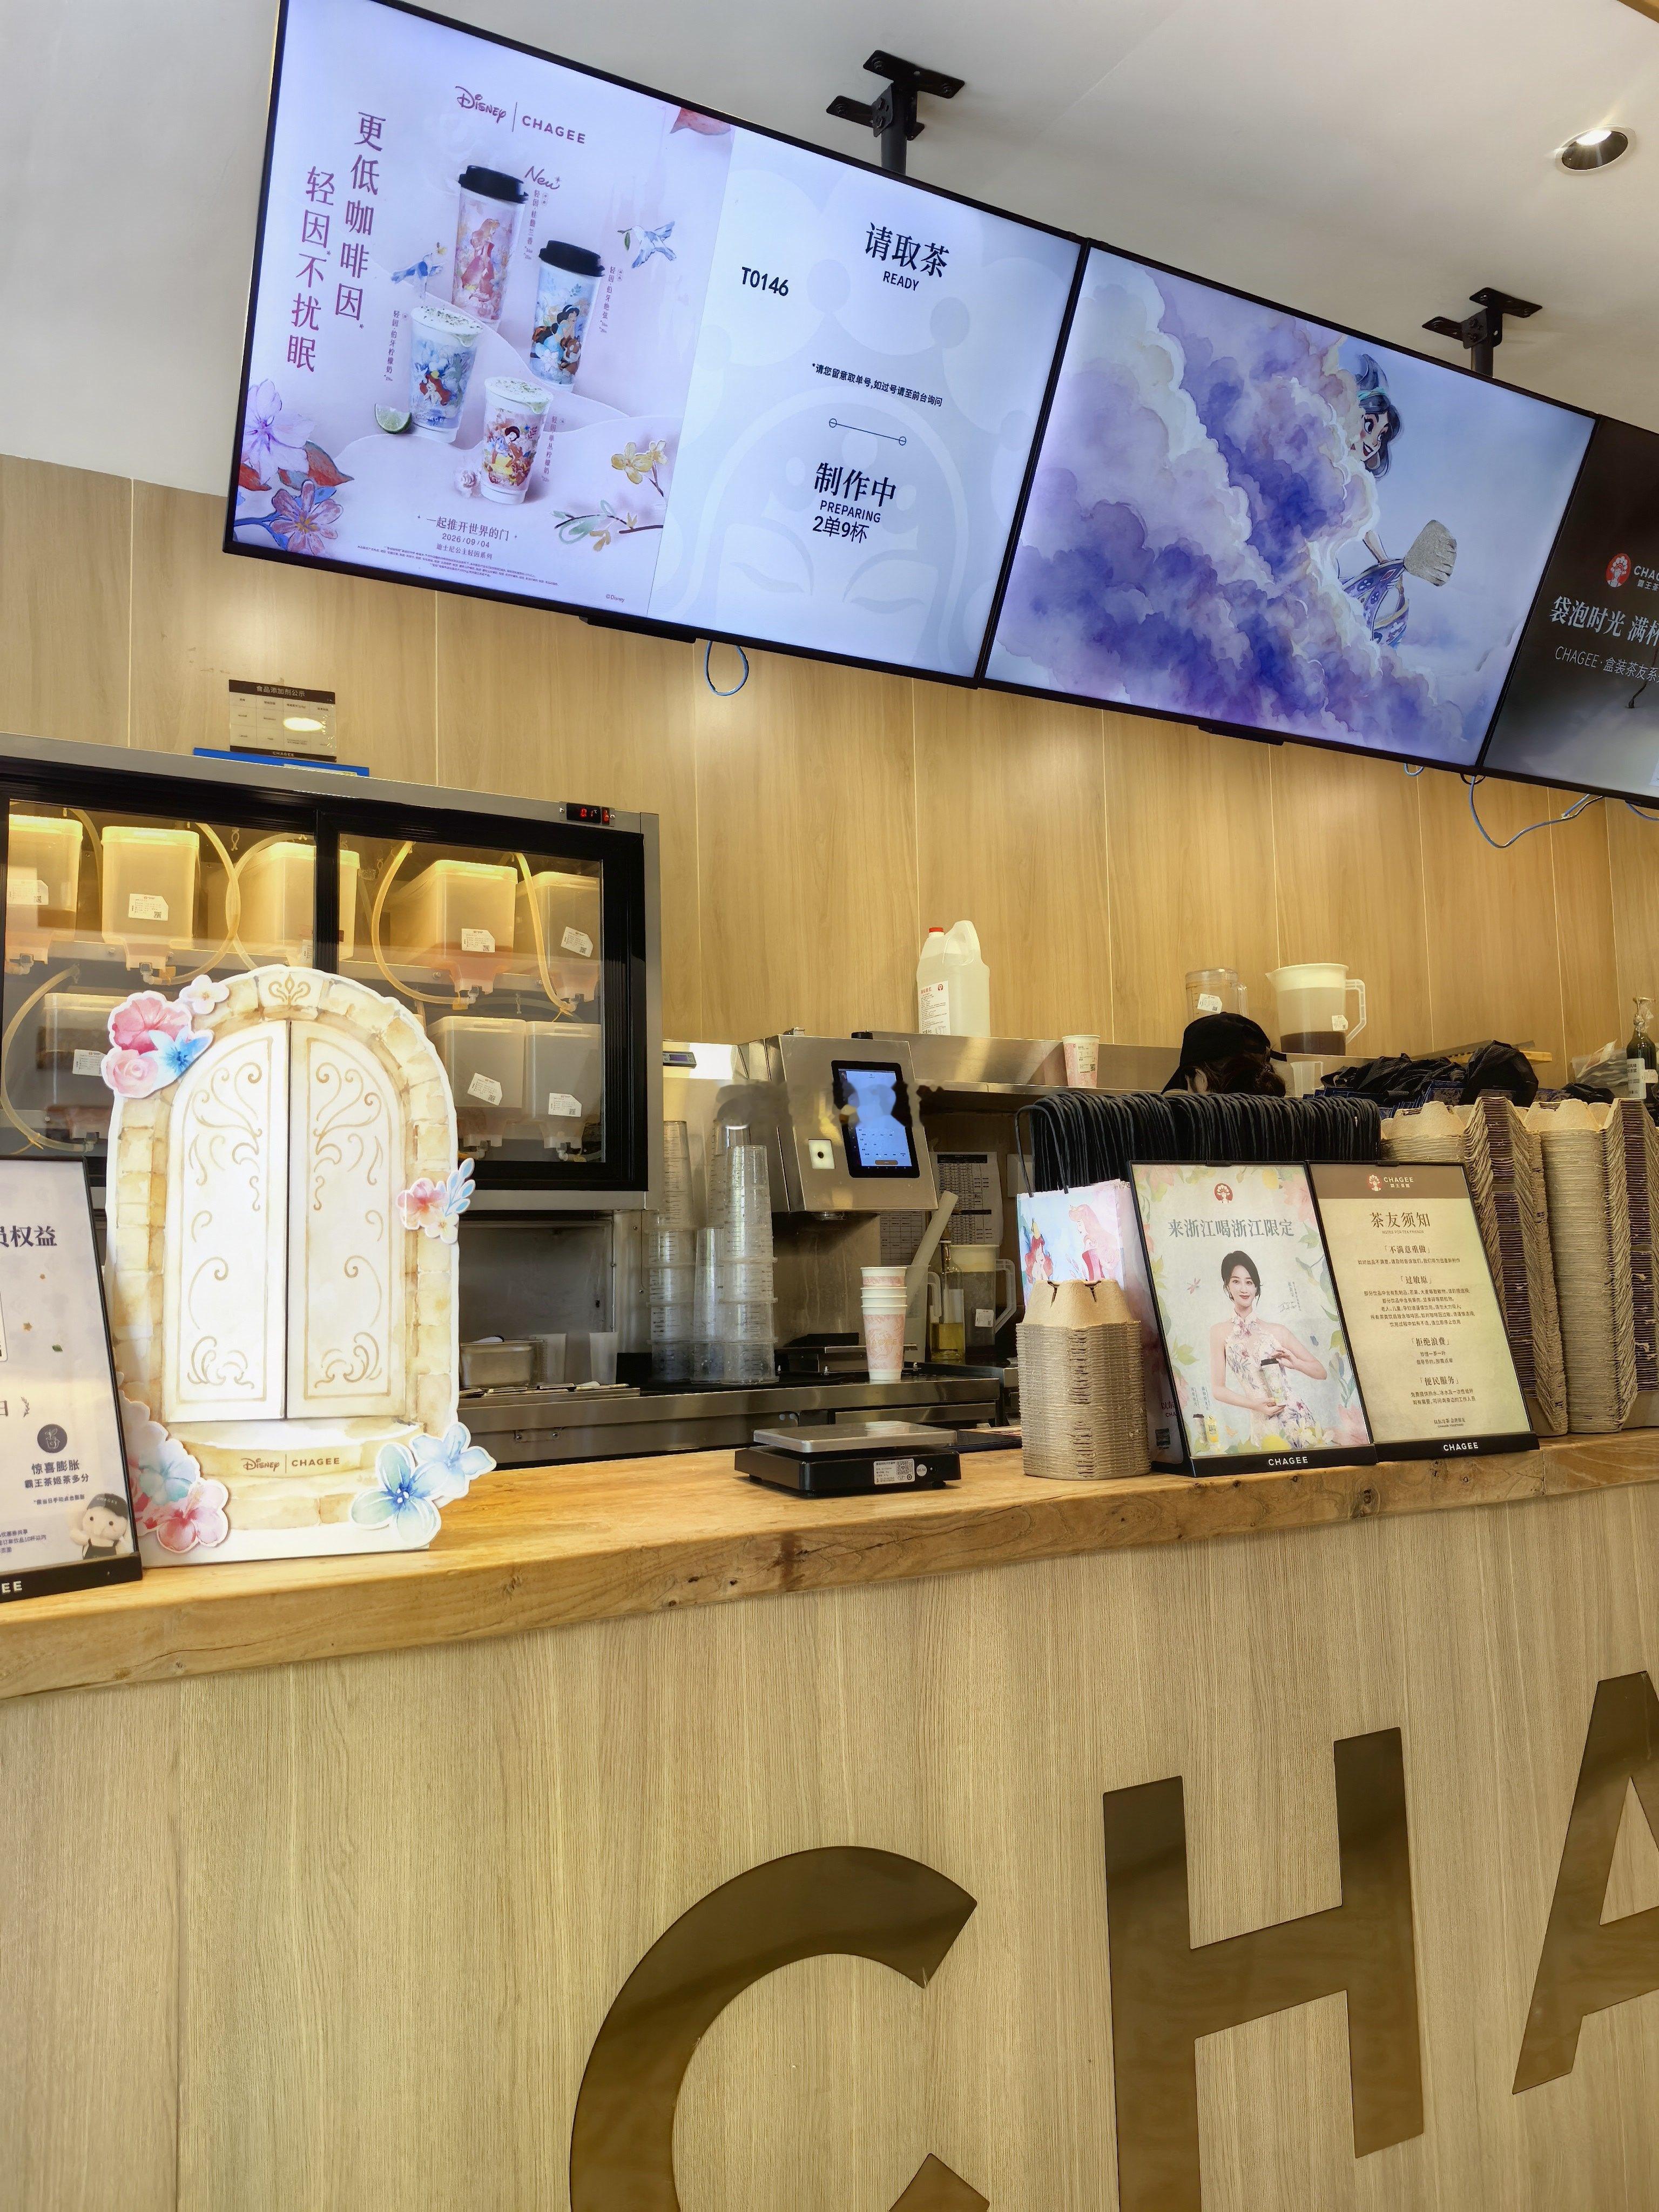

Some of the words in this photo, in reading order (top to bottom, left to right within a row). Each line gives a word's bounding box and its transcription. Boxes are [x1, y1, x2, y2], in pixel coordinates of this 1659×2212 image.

[455, 86, 506, 123] Disney
[522, 116, 585, 144] CHAGEE
[524, 166, 559, 190] New
[865, 222, 949, 278] 请取茶
[741, 266, 789, 296] T0146
[883, 271, 919, 292] READY
[814, 462, 896, 508] 制作中
[820, 499, 881, 523] PREPARING
[426, 516, 509, 541] 一起推开世界的门
[812, 515, 869, 544] 2单9杯
[442, 533, 490, 548] 2026/09/04
[436, 543, 493, 560] 迪士尼公主轻因系列
[1549, 595, 1627, 637] 袋泡时光
[256, 685, 305, 697] 食品添加剂公示
[1168, 1218, 1294, 1238] 来浙江喝浙江限定
[1370, 1212, 1431, 1228] 茶友须知
[1443, 1442, 1479, 1451] CHAGEE
[31, 1459, 80, 1475] 惊喜膨胀
[241, 1458, 280, 1472] Disney
[292, 1458, 340, 1467] CHAGEE
[1268, 1456, 1309, 1467] CHAGEE
